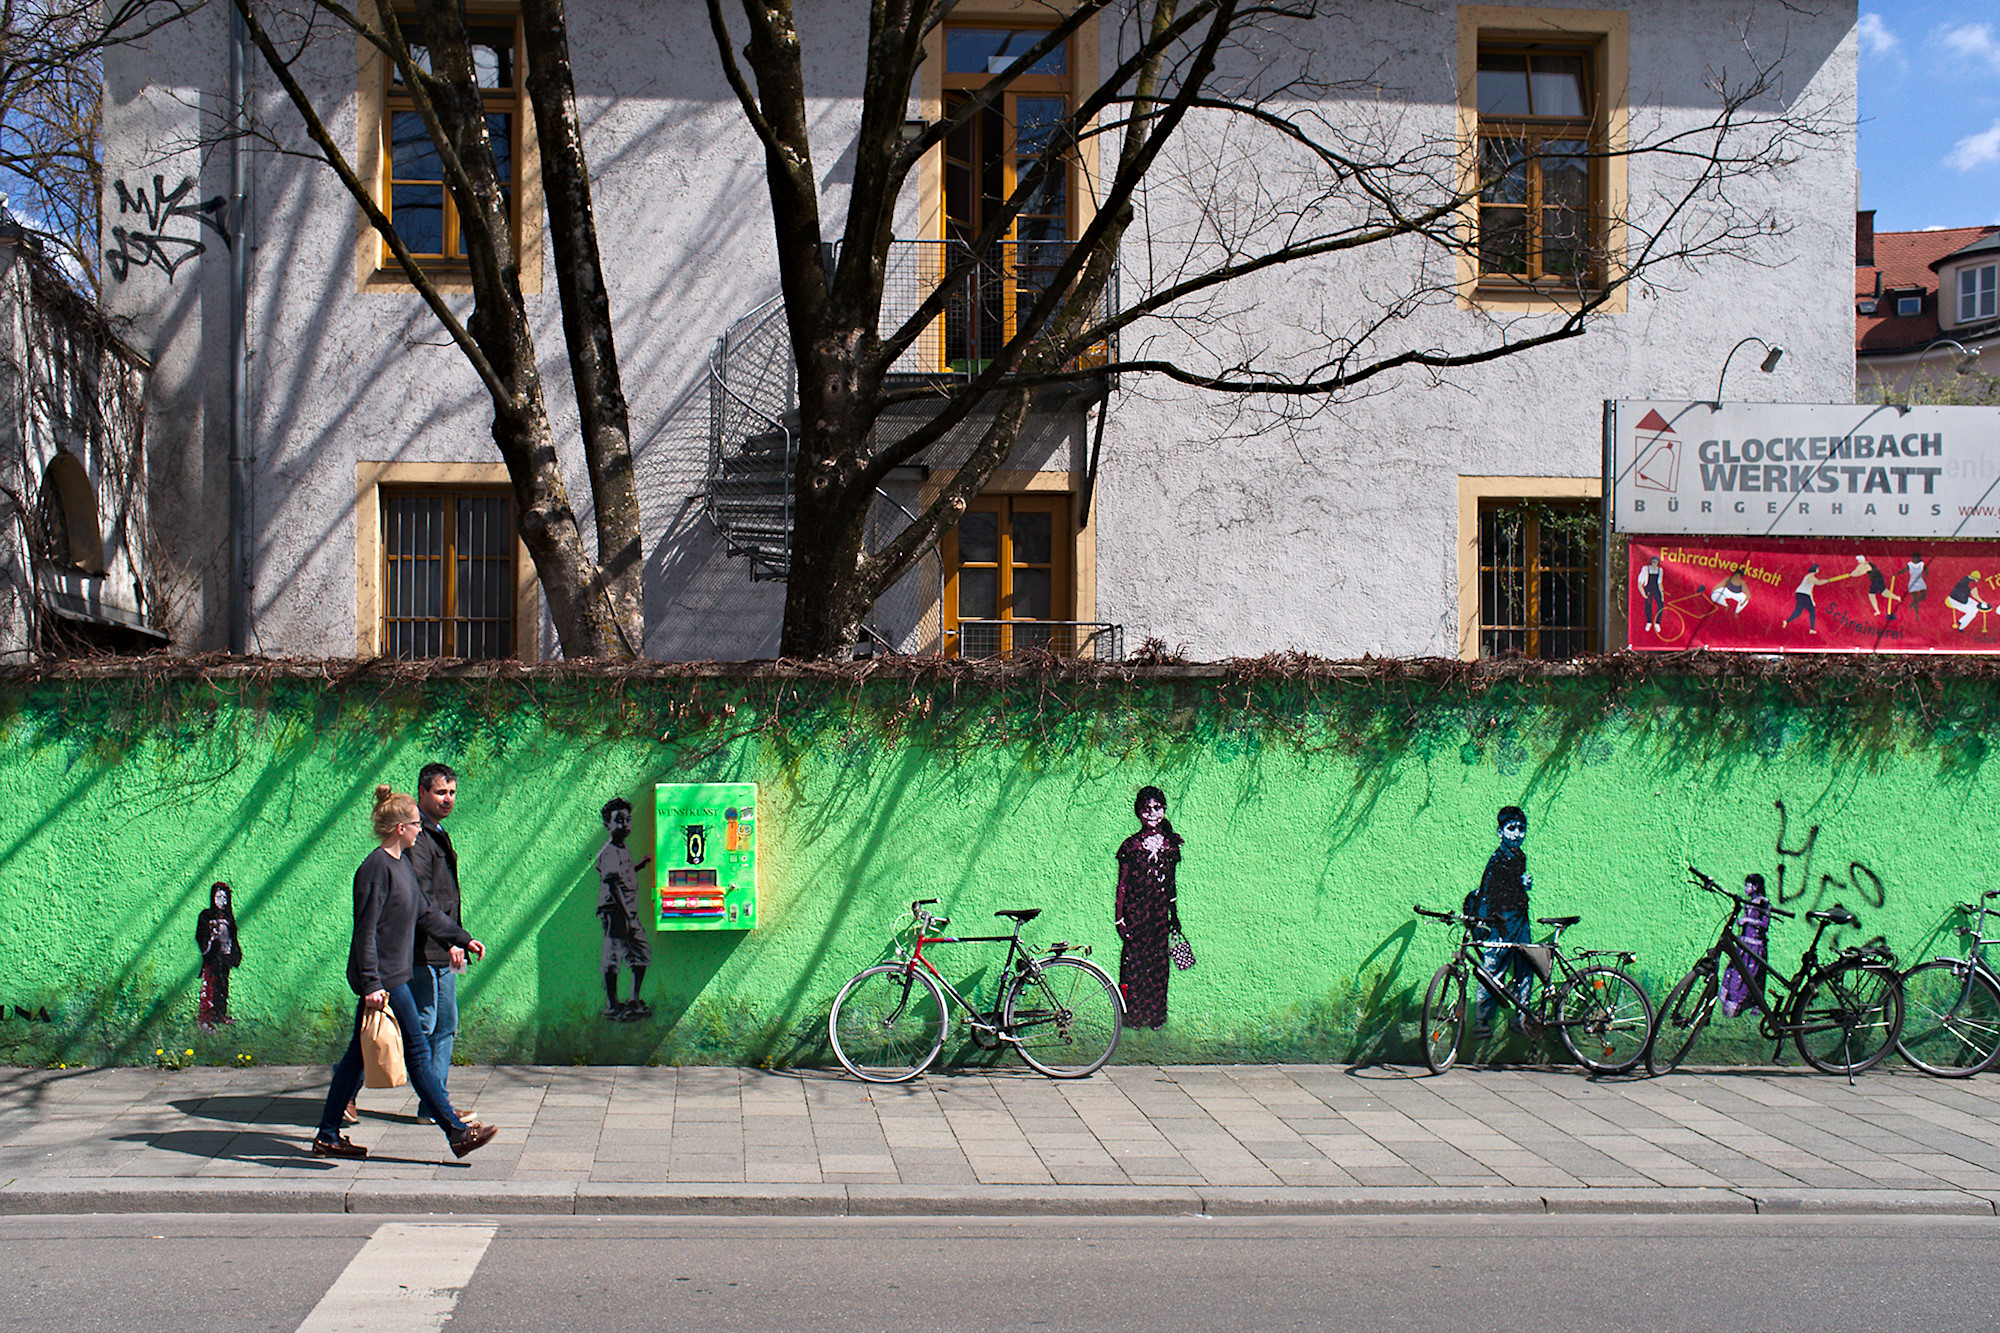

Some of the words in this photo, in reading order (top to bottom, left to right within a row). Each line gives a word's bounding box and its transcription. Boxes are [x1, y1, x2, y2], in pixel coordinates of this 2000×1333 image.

[1698, 432, 1943, 464] GLOCKENBACH
[1699, 463, 1943, 494] WERKSTATT
[1946, 452, 2000, 479] enb
[1634, 496, 1942, 516] BÜRGERHAUS
[1660, 547, 1782, 587] Fahrradwerkstatt
[1825, 602, 1904, 640] Schreinerei
